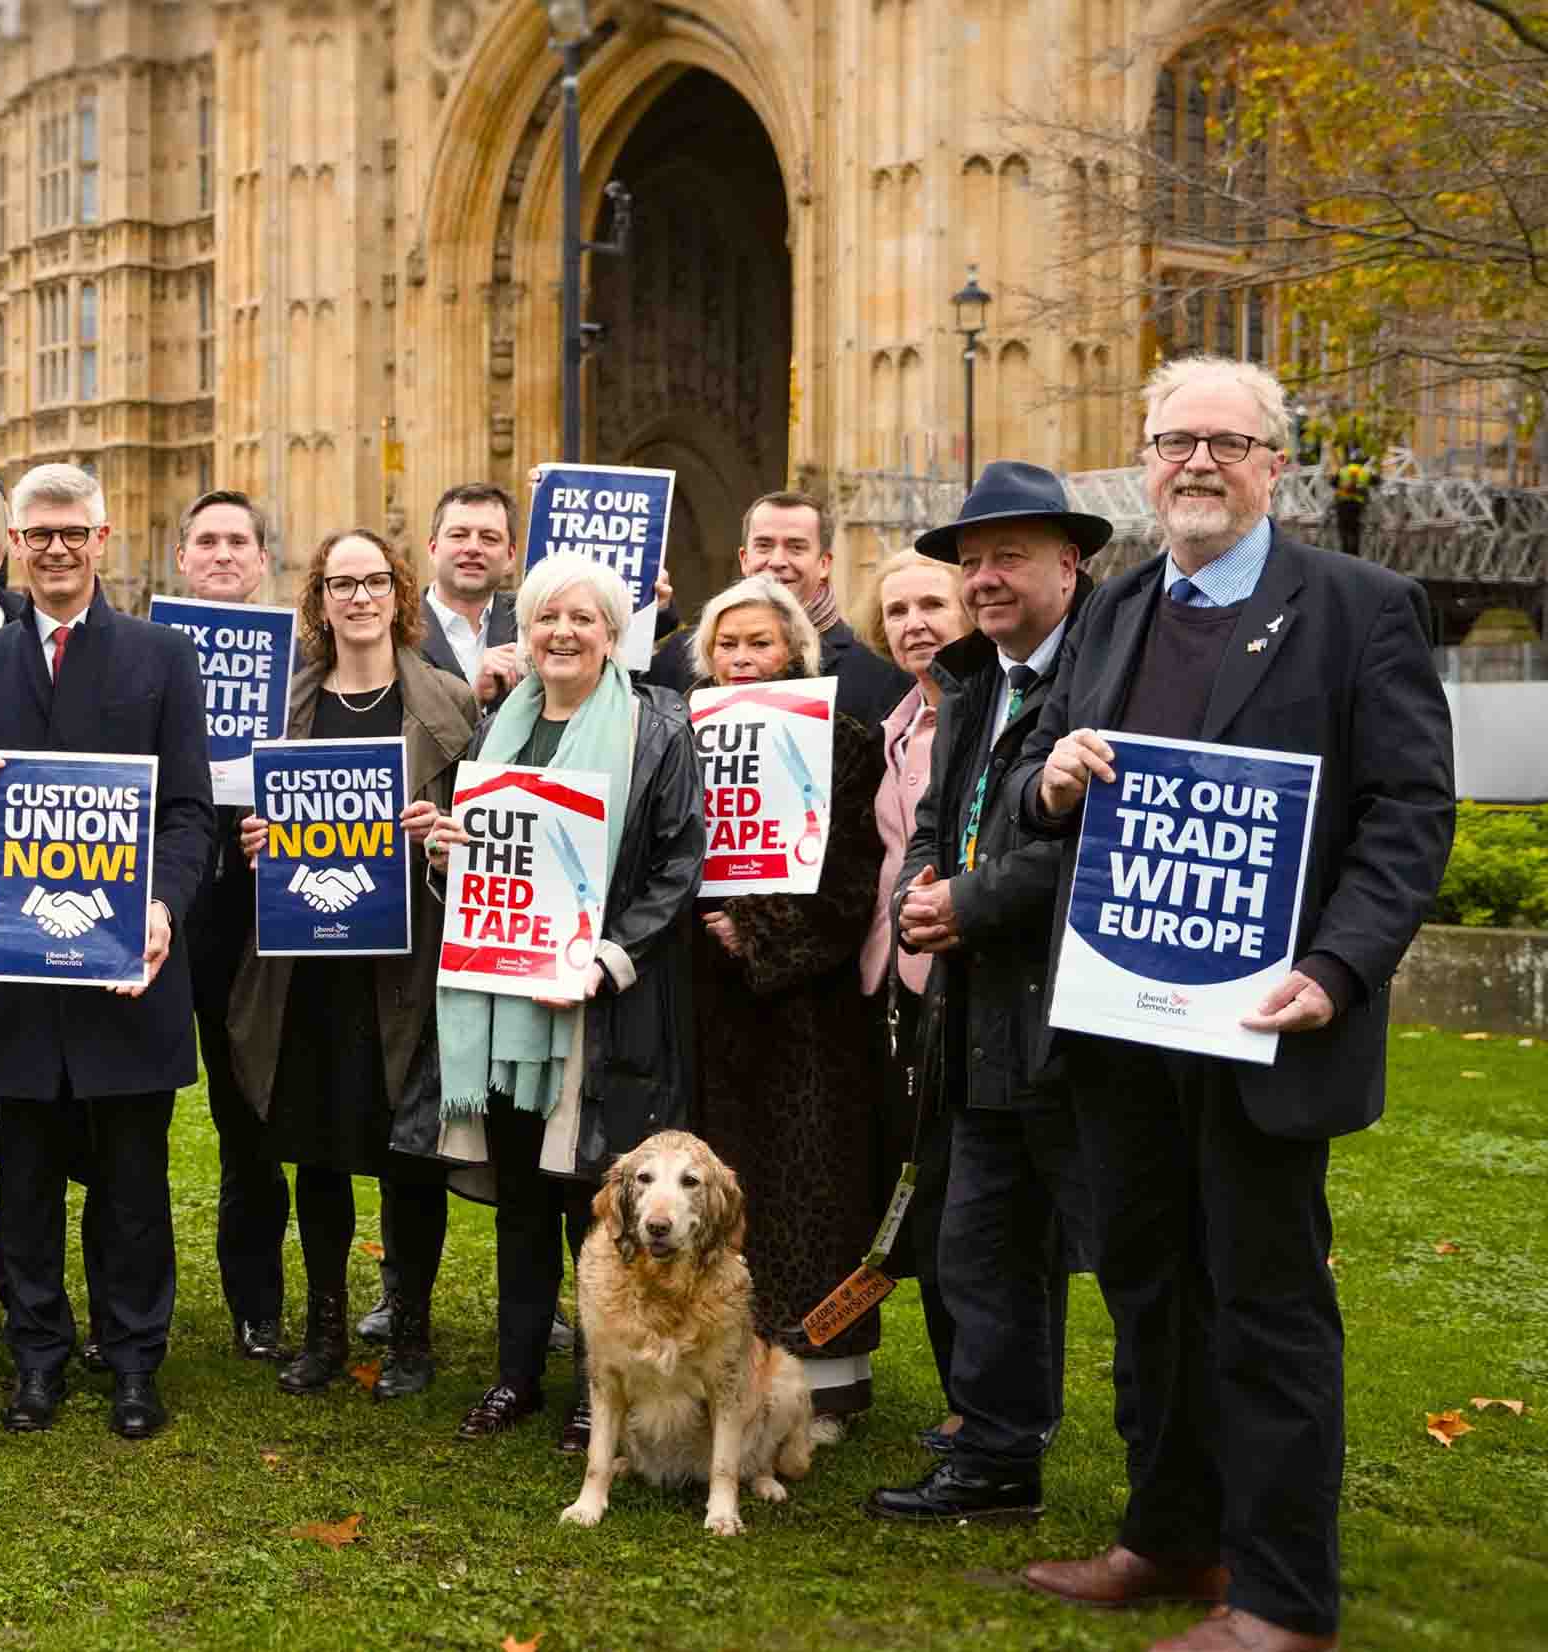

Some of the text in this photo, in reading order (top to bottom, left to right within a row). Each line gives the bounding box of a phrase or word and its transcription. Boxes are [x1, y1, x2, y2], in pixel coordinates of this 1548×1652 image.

[551, 488, 650, 514] FIX OUR
[548, 512, 649, 544] TRADE
[215, 628, 273, 651] OUR
[198, 652, 272, 679] ADE
[203, 680, 268, 712] ITH
[205, 714, 268, 738] OPE
[694, 722, 765, 753] CUT
[265, 768, 393, 792] CUSTOMS
[699, 754, 759, 784] THE
[6, 783, 140, 810] CUSTOMS
[266, 791, 393, 821] UNION
[1121, 771, 1279, 822] FIX OUR
[4, 808, 138, 842] UNION
[268, 822, 394, 859] NOW!
[463, 807, 538, 842] CUT
[705, 820, 786, 850] APE.
[1116, 808, 1277, 867] TRADE
[3, 841, 137, 882] NOW!
[467, 840, 534, 876] THE
[462, 873, 534, 909] RED
[1110, 852, 1268, 918] WITH
[458, 907, 558, 948] TAPE.
[1098, 902, 1265, 959] EUROPE
[1136, 1000, 1187, 1015] Democrats
[1137, 992, 1168, 1005] Liberal
